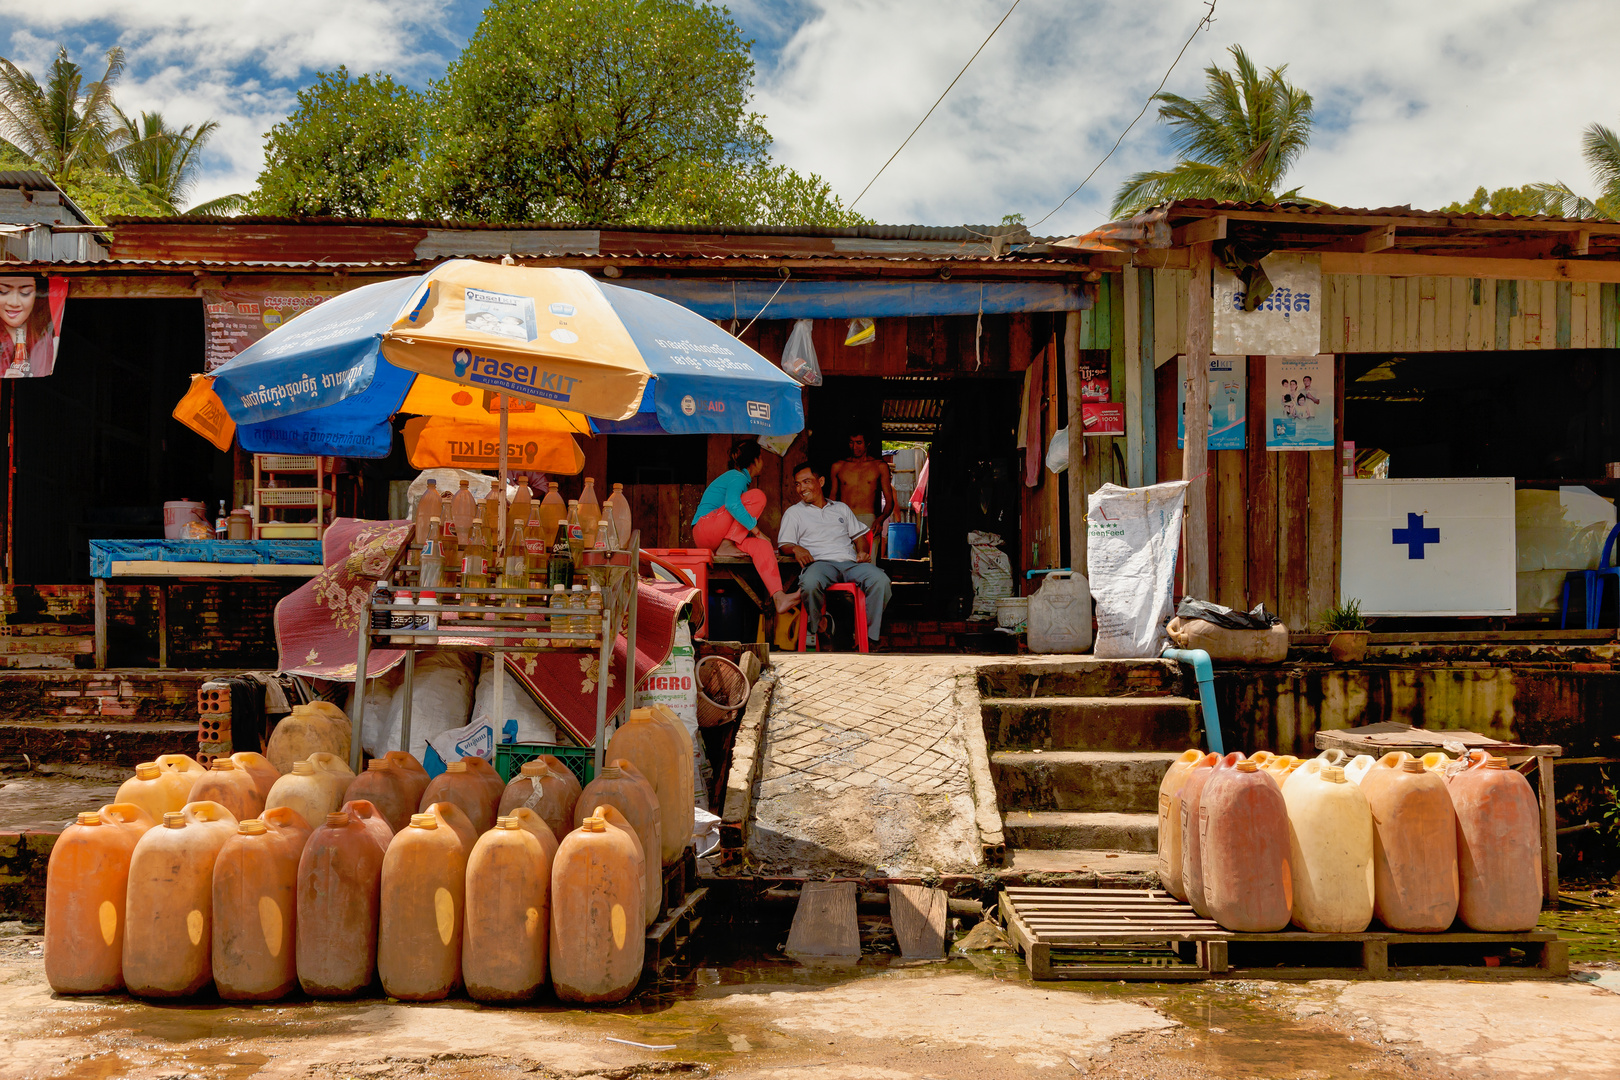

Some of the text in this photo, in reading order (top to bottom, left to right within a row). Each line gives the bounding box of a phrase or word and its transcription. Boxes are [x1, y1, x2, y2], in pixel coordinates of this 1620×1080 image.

[453, 347, 538, 385] Orasel
[541, 371, 579, 393] KIT
[696, 400, 725, 412] USAID
[748, 402, 770, 419] PSI
